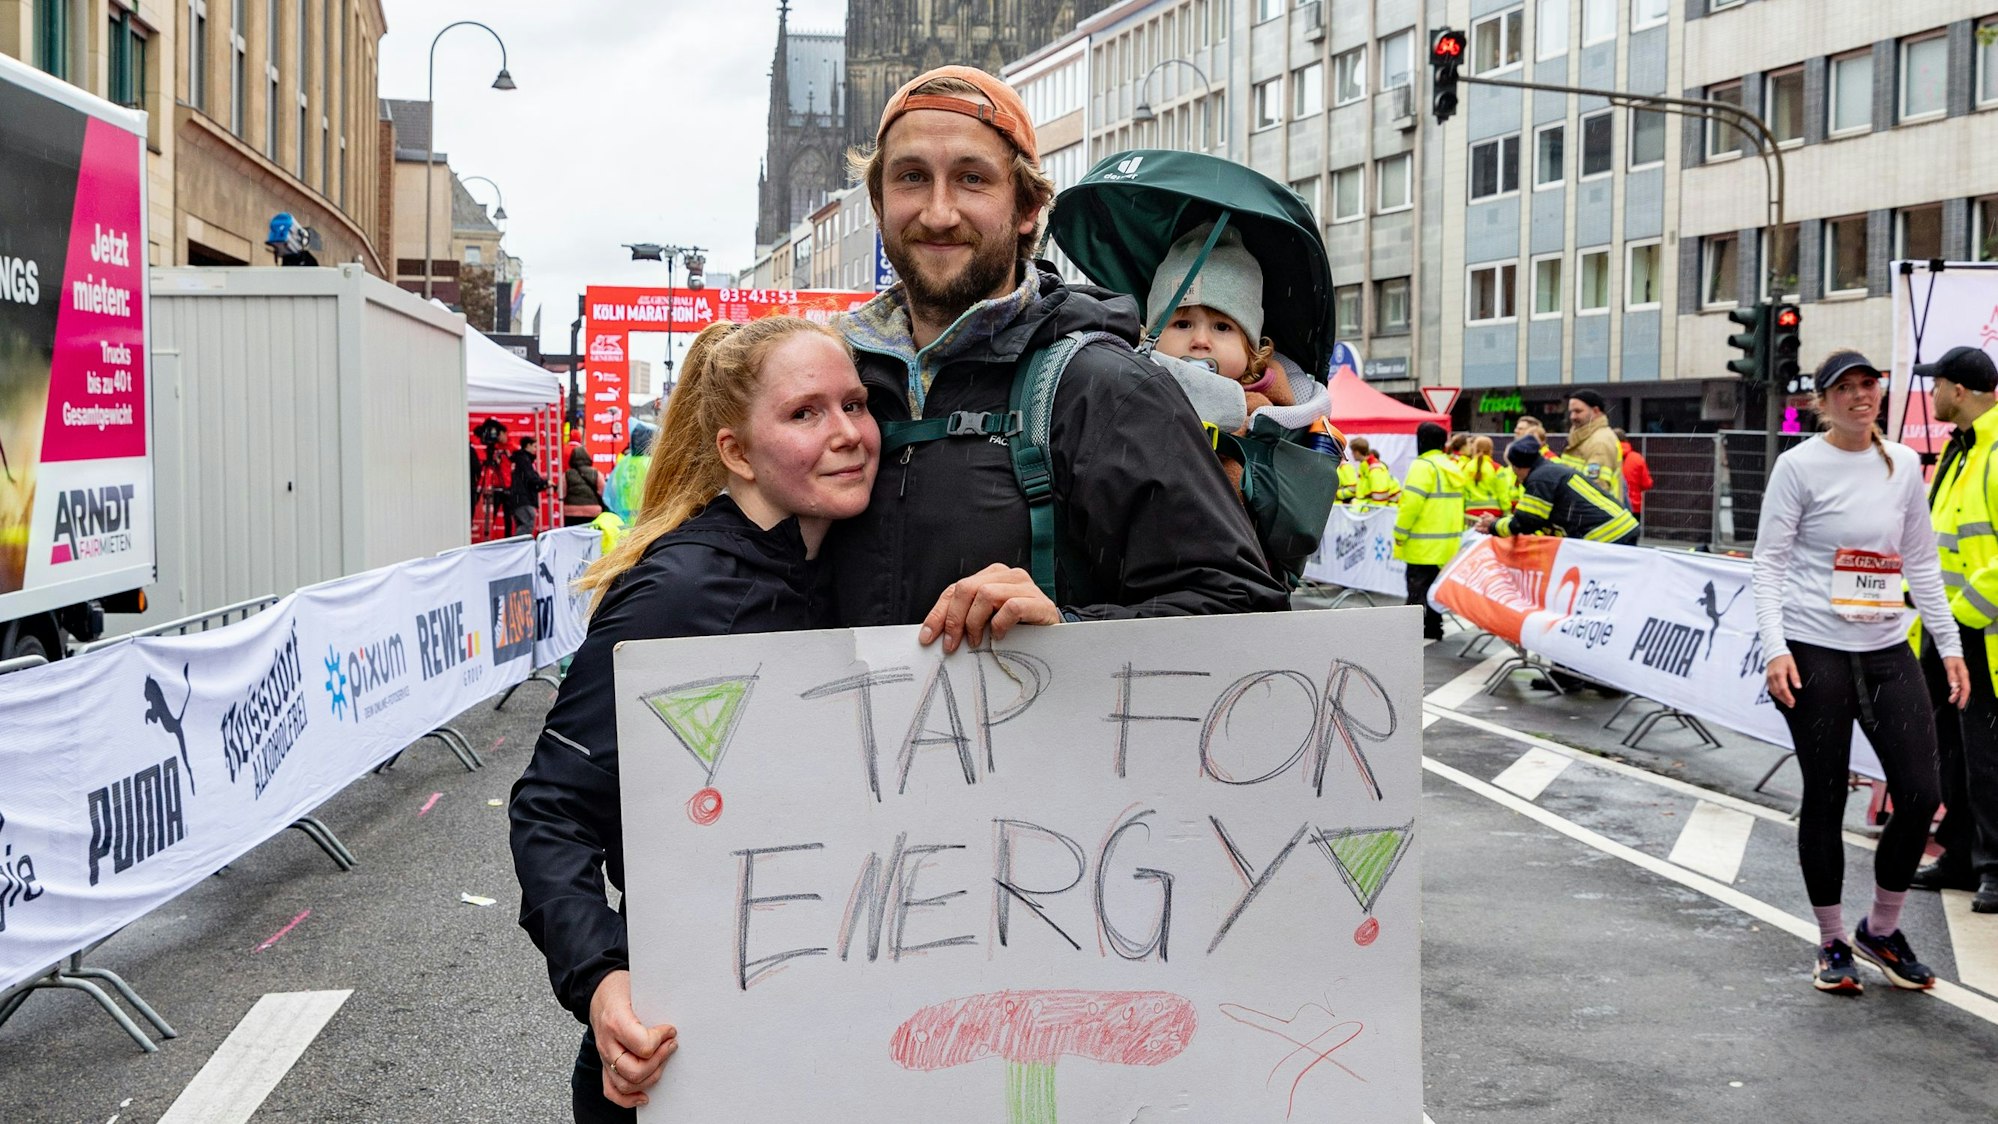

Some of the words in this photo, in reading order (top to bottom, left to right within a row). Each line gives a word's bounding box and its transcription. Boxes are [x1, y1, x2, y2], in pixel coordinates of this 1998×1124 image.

[91, 223, 129, 267] Jetzt
[73, 273, 130, 317] mieten:
[593, 303, 625, 321] KÖLN
[719, 288, 797, 304] 03:41:53
[101, 340, 131, 365] Trucks
[87, 370, 101, 394] bis
[102, 377, 113, 394] zu
[114, 369, 126, 392] 40
[127, 374, 132, 392] t
[62, 401, 133, 431] Gesamtgewicht
[989, 435, 1009, 446] FAC
[53, 484, 134, 560] ARNDT
[80, 532, 131, 560] FAIRMIETEN
[1577, 579, 1619, 612] Rhein
[416, 601, 466, 682] REWE
[1561, 610, 1614, 649] Energie
[1629, 617, 1705, 678] PUMA
[348, 632, 407, 724] pixum
[463, 664, 483, 687] GROUP
[800, 647, 1052, 802] TAP
[1102, 658, 1397, 800] FOR
[252, 690, 308, 801] ALKOHOLFREI
[87, 755, 185, 887] PUMA
